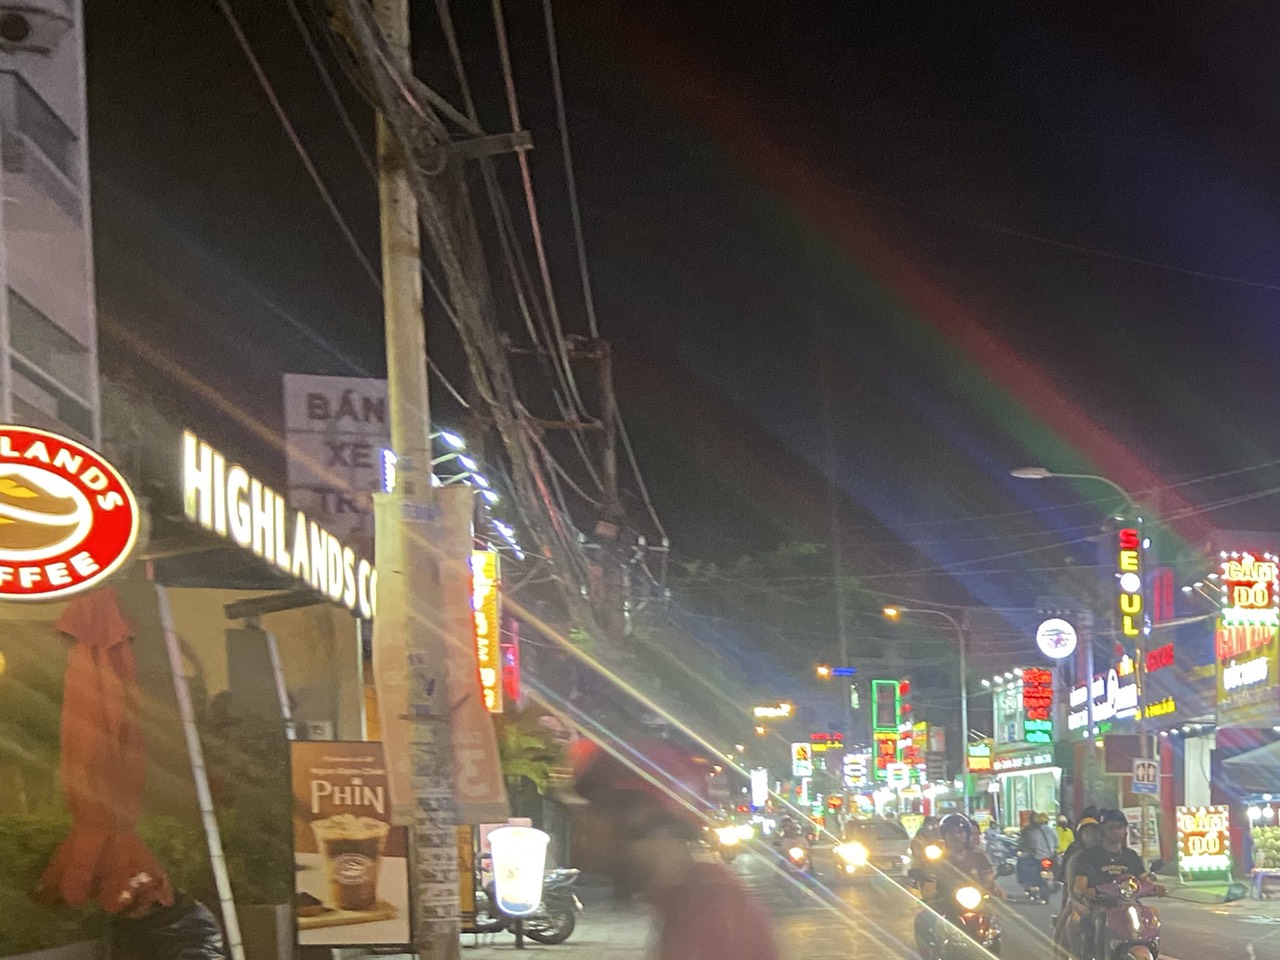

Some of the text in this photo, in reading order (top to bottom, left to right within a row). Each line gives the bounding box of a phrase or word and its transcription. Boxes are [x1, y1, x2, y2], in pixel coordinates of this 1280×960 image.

[307, 387, 387, 423] BÁN
[325, 440, 373, 468] XE
[184, 429, 356, 610] HIGHLANDS
